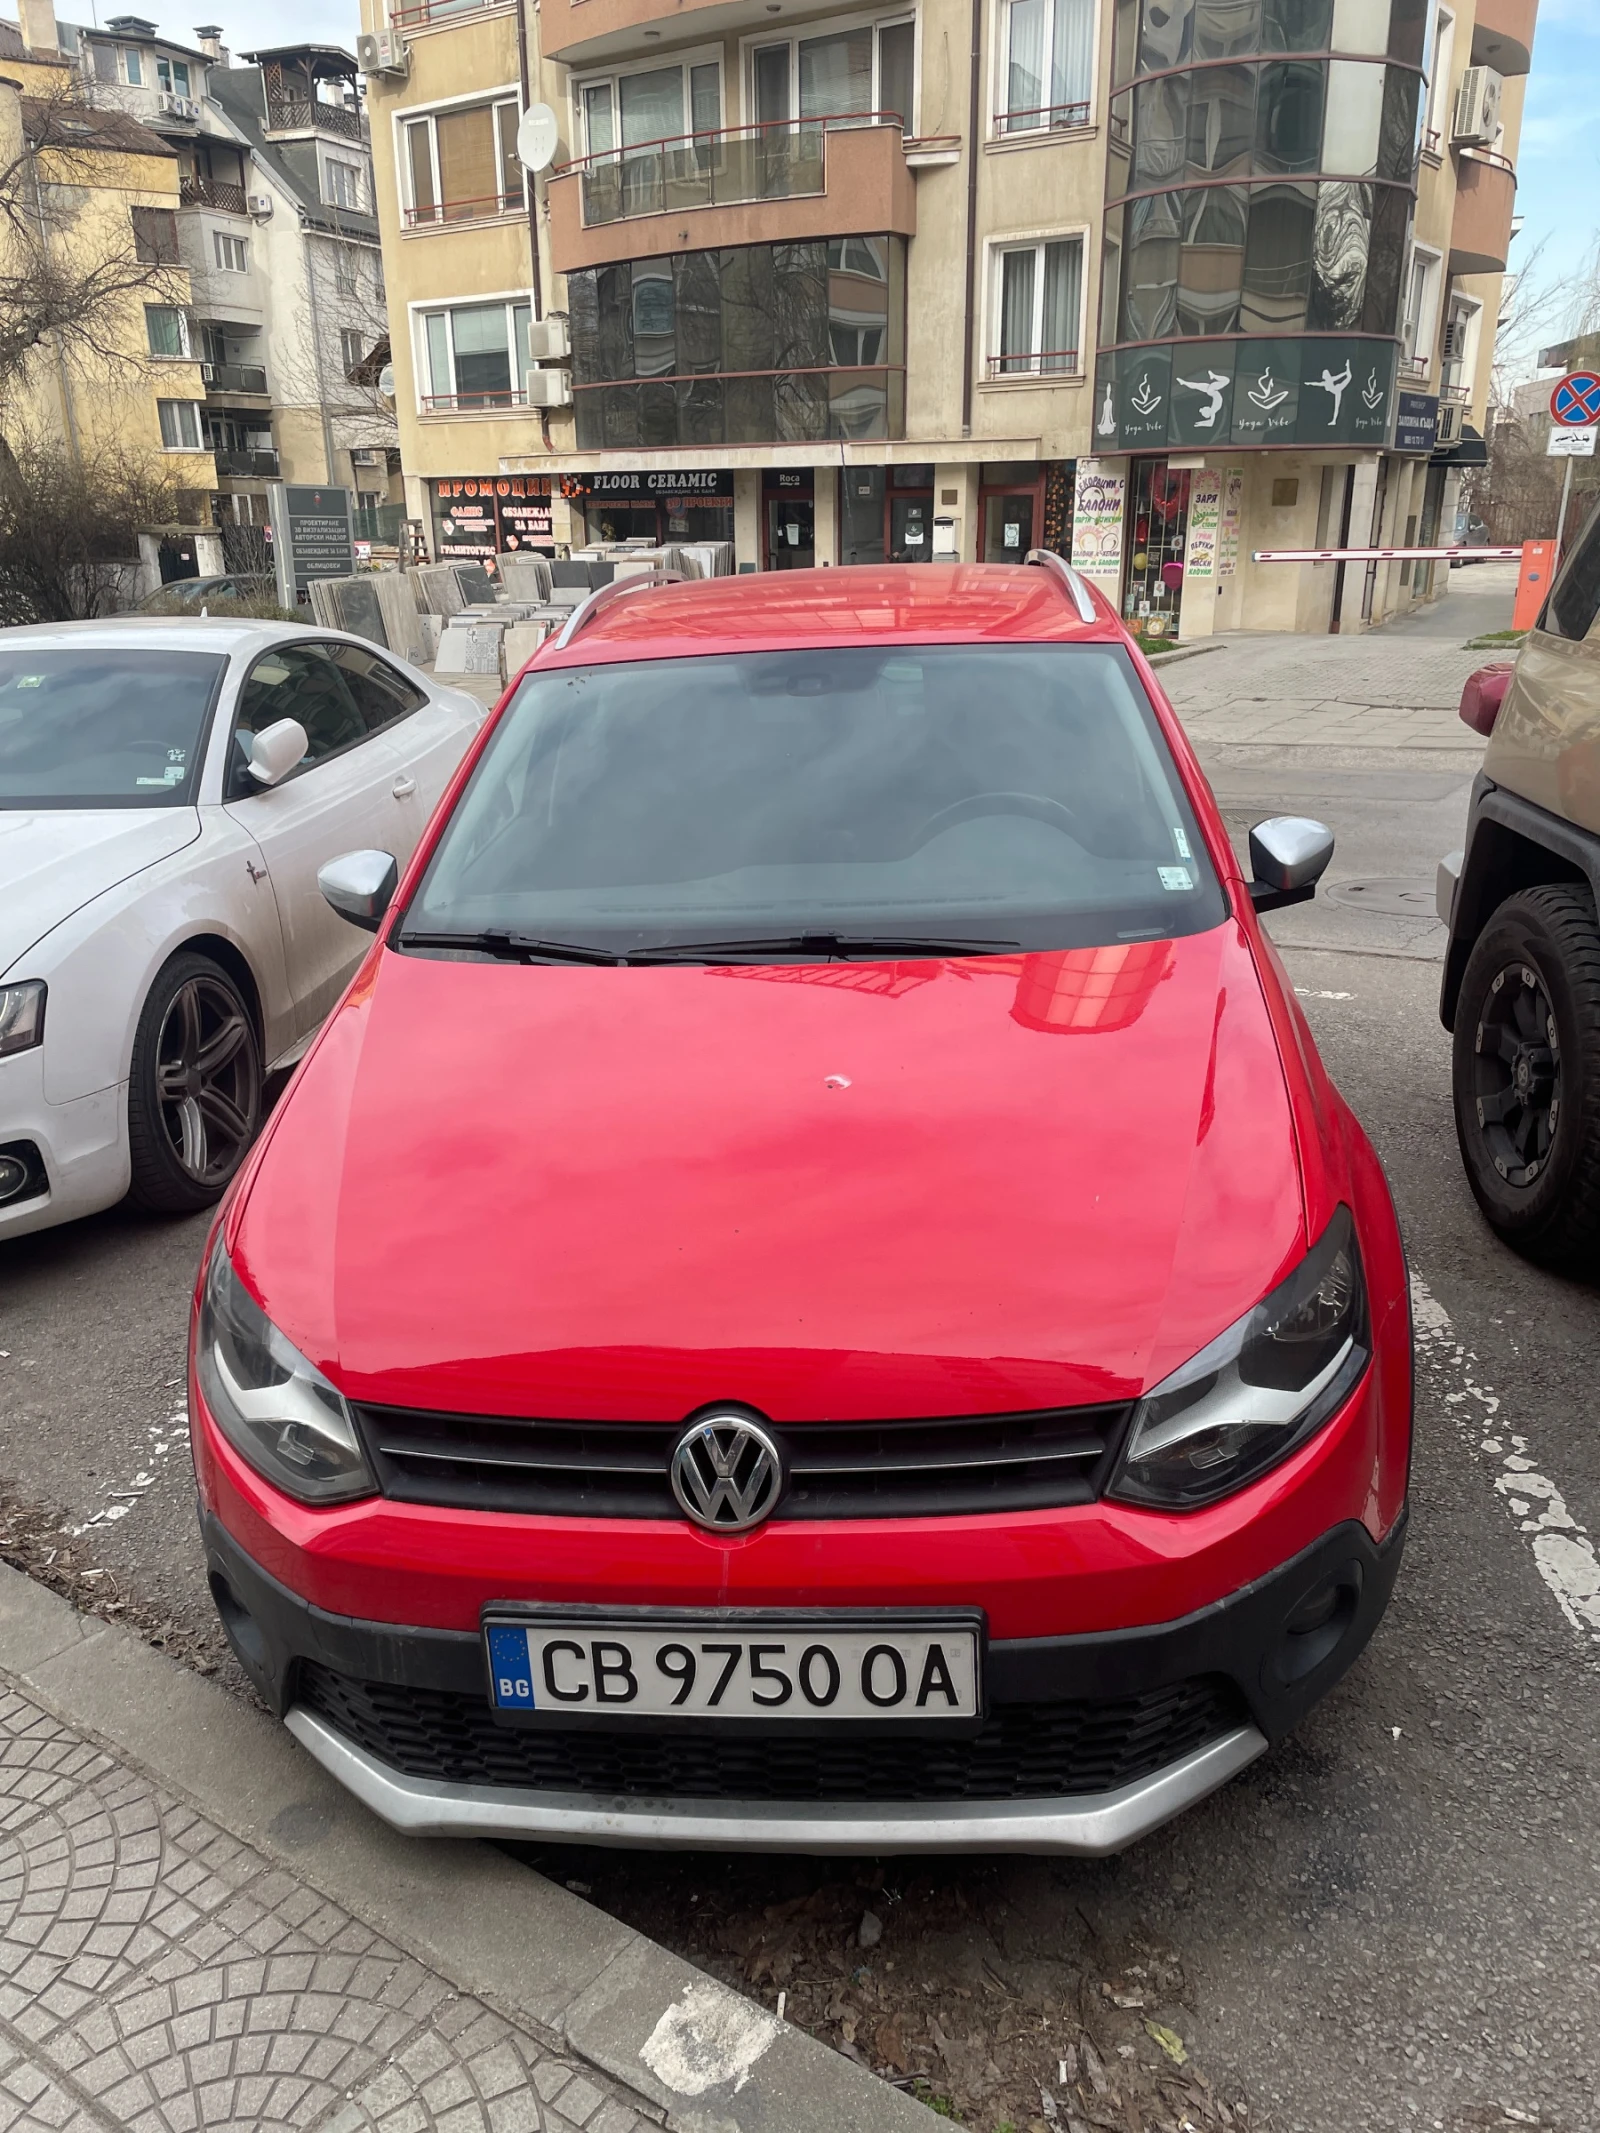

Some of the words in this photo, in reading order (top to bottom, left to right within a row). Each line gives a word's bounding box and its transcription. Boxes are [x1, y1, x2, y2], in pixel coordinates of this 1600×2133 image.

[1125, 424, 1142, 436] Yoga
[1239, 418, 1263, 431] Yoga
[593, 475, 640, 489] FLOOR
[648, 473, 717, 488] CERAMIC
[779, 474, 800, 483] Roca
[1195, 494, 1218, 503] ЗАРЯ
[1077, 499, 1121, 512] БАЛОНИ
[450, 506, 484, 517] ФАЯНС
[515, 520, 526, 530] ЗА
[527, 520, 549, 531] БАНЯ
[440, 545, 496, 555] ГРАНИТОГРЕС
[1190, 541, 1214, 550] ПЕРУКИ
[542, 1640, 640, 1703] CB
[655, 1643, 841, 1706] 9750
[860, 1643, 960, 1707] OA
[499, 1678, 530, 1698] BG
